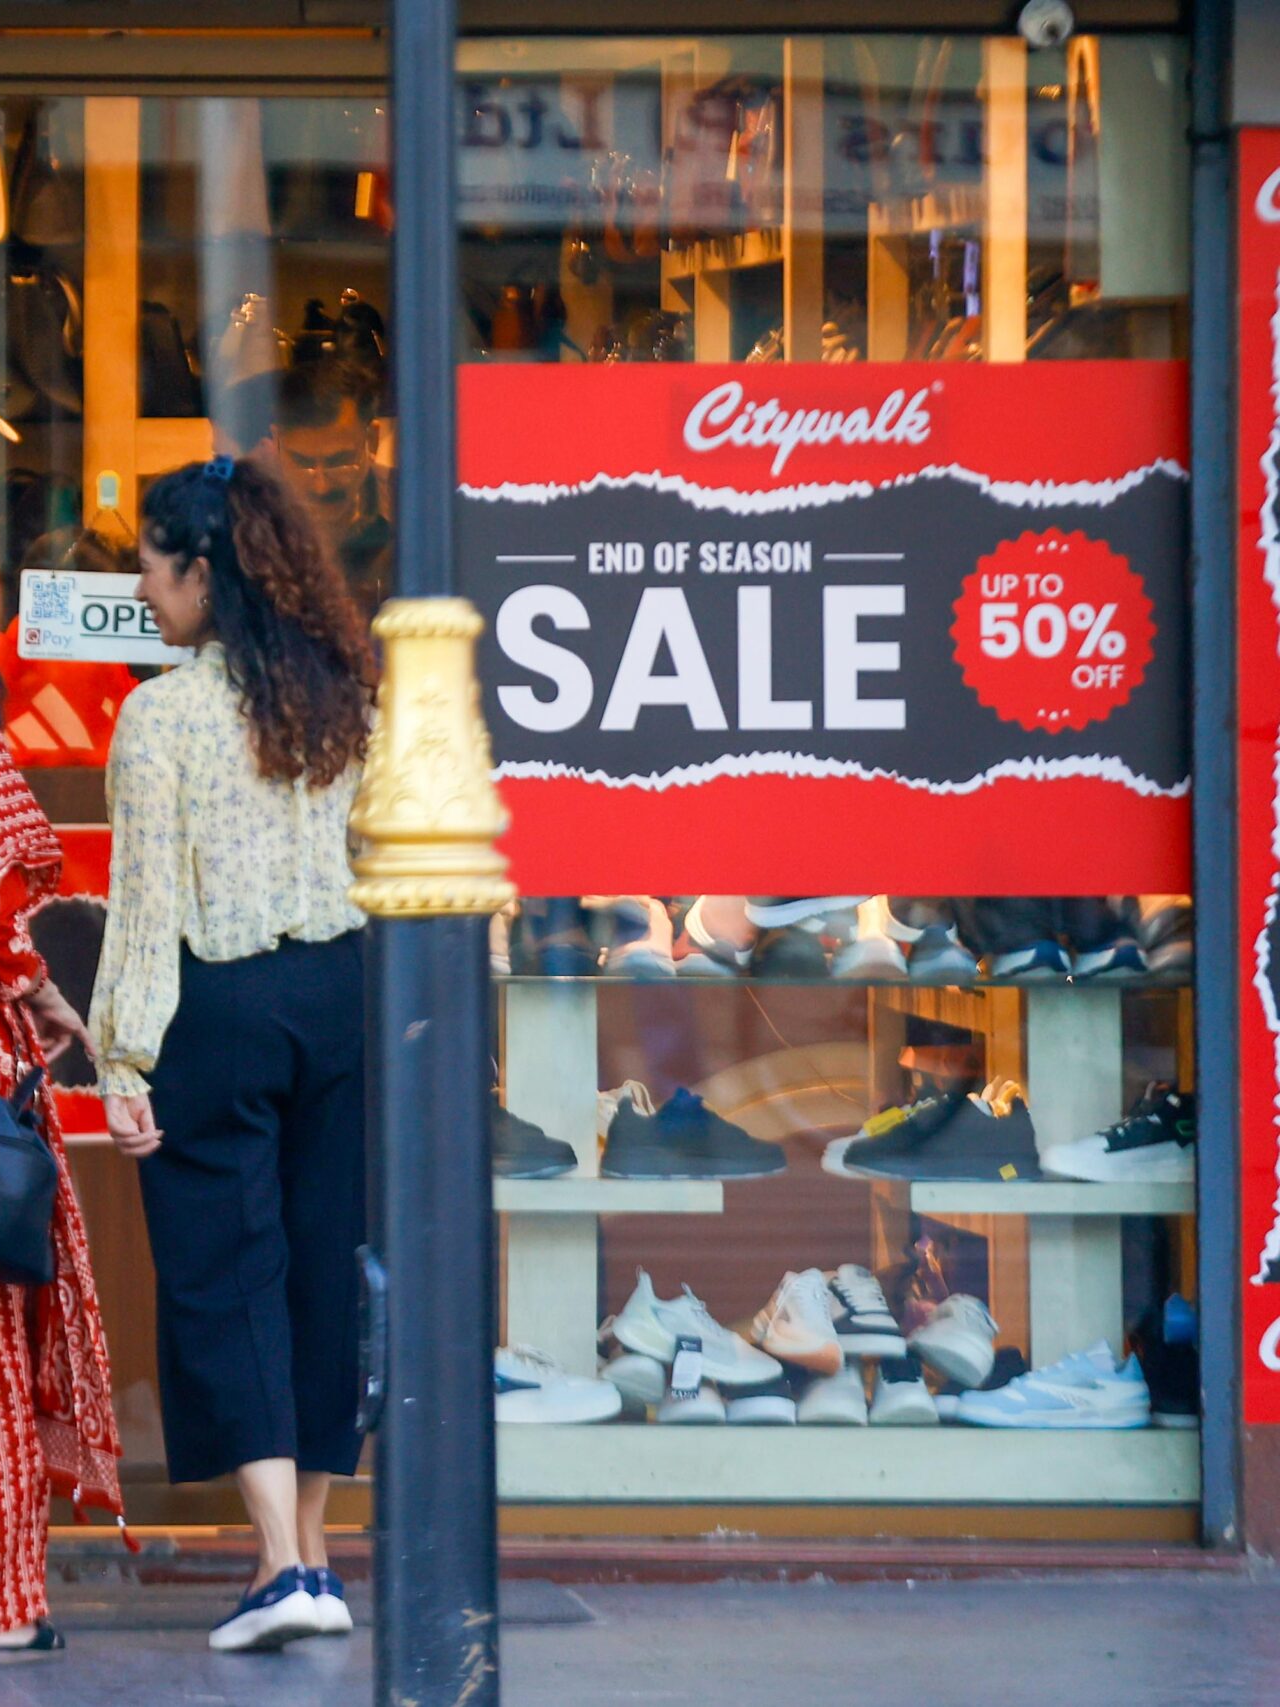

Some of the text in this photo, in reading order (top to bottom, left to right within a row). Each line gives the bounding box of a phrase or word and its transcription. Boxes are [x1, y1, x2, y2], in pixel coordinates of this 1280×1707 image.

[683, 380, 931, 477] Citywalk
[588, 541, 812, 575] END OF SEASON
[981, 573, 1064, 598] UP TO
[81, 602, 161, 634] OPE
[980, 602, 1127, 659] 50%
[42, 630, 73, 648] Pay
[495, 584, 906, 733] SALE
[1071, 664, 1124, 689] OFF
